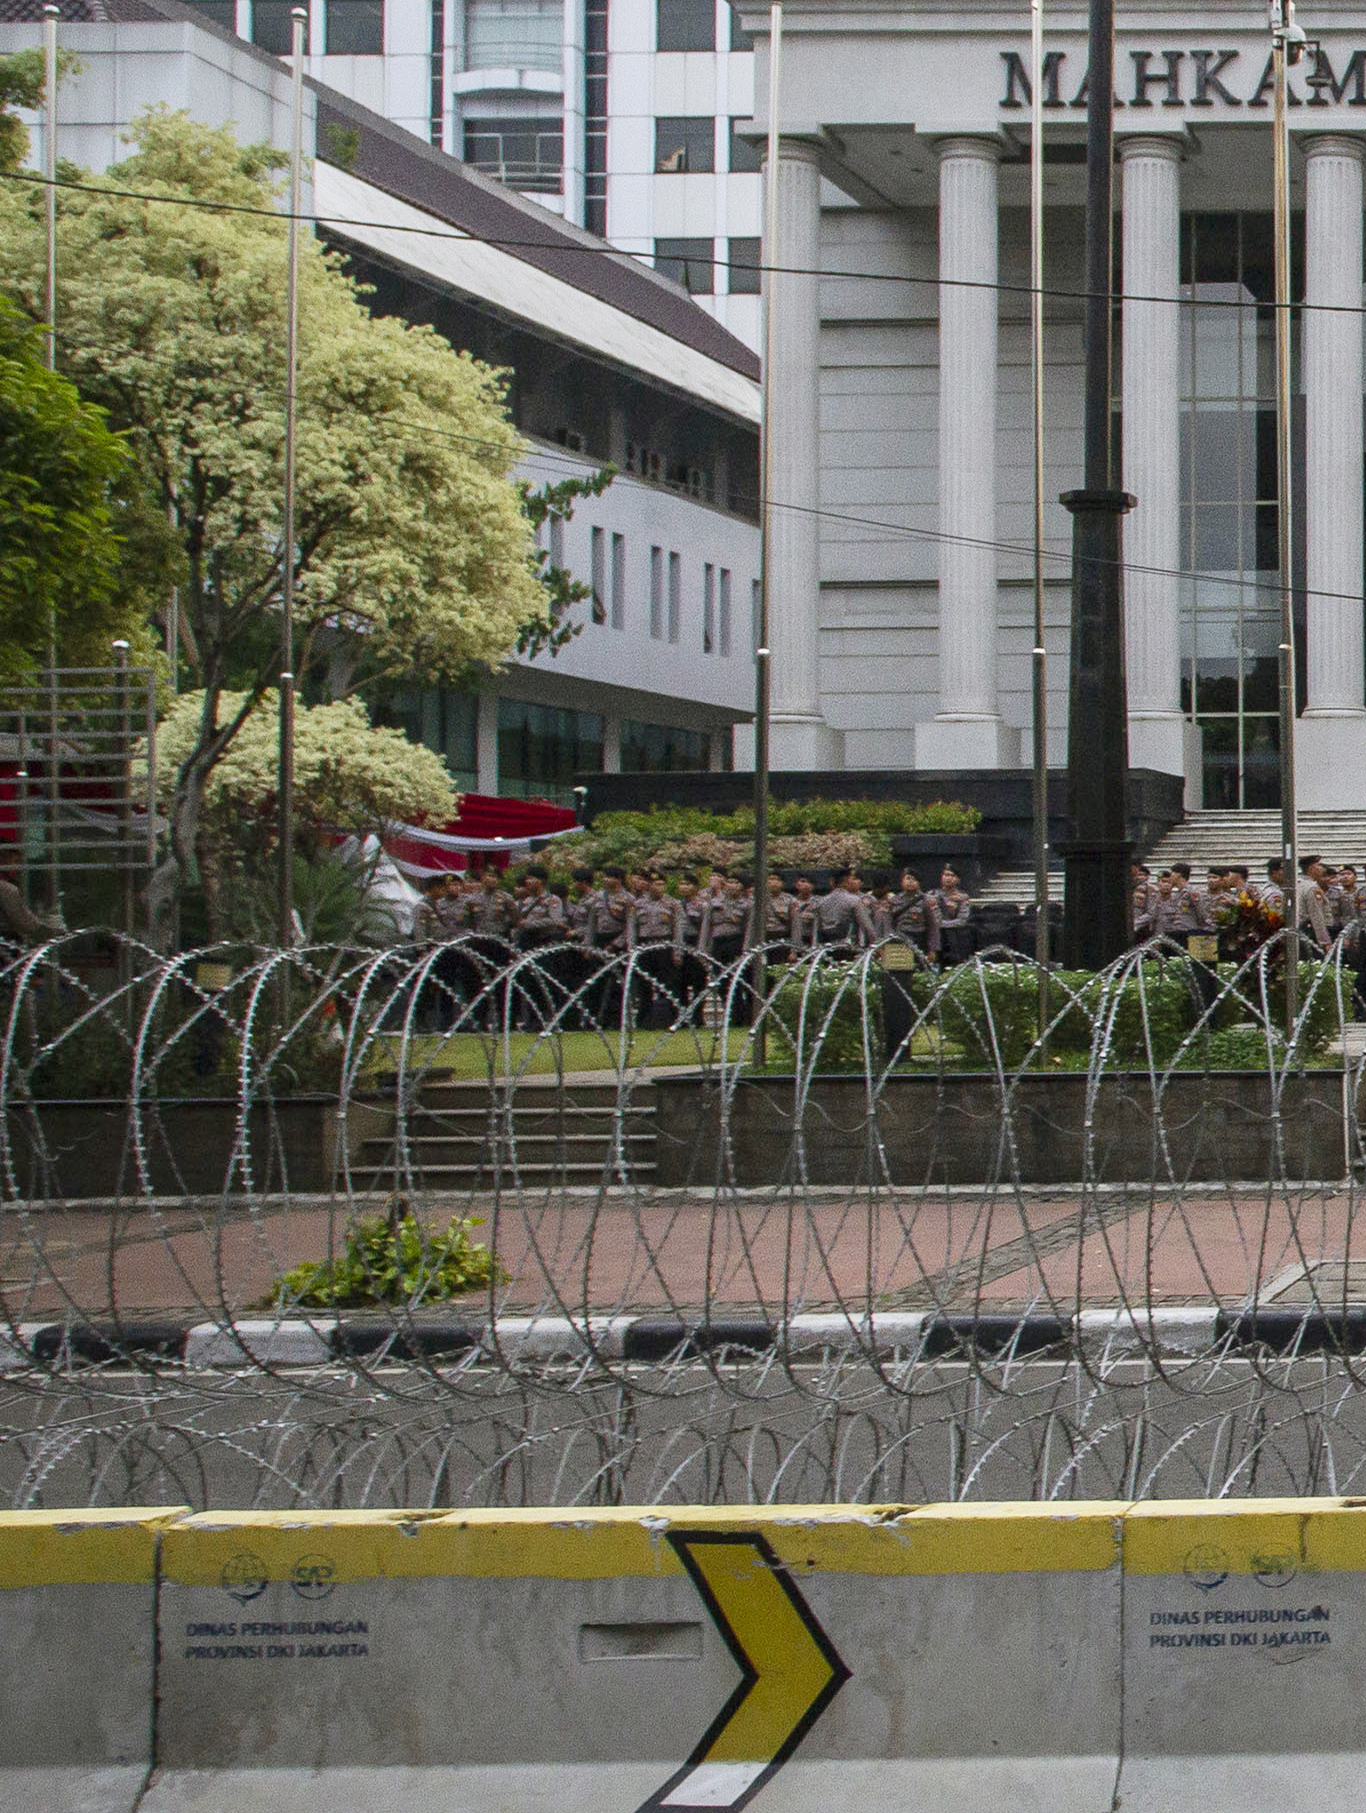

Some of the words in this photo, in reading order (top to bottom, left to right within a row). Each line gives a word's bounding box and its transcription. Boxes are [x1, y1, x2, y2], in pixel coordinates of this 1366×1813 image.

[1150, 1611, 1200, 1625] DINAS
[1203, 1608, 1330, 1624] PERHUBUNGAN
[186, 1622, 237, 1637] DINAS
[240, 1620, 369, 1636] PERHUBUNGAN
[1150, 1633, 1226, 1648] PROVINSI
[1230, 1632, 1257, 1646] DKI
[1262, 1631, 1331, 1647] JAKARTA
[185, 1644, 263, 1659] PROVINSI
[297, 1642, 369, 1658] JAKARTA
